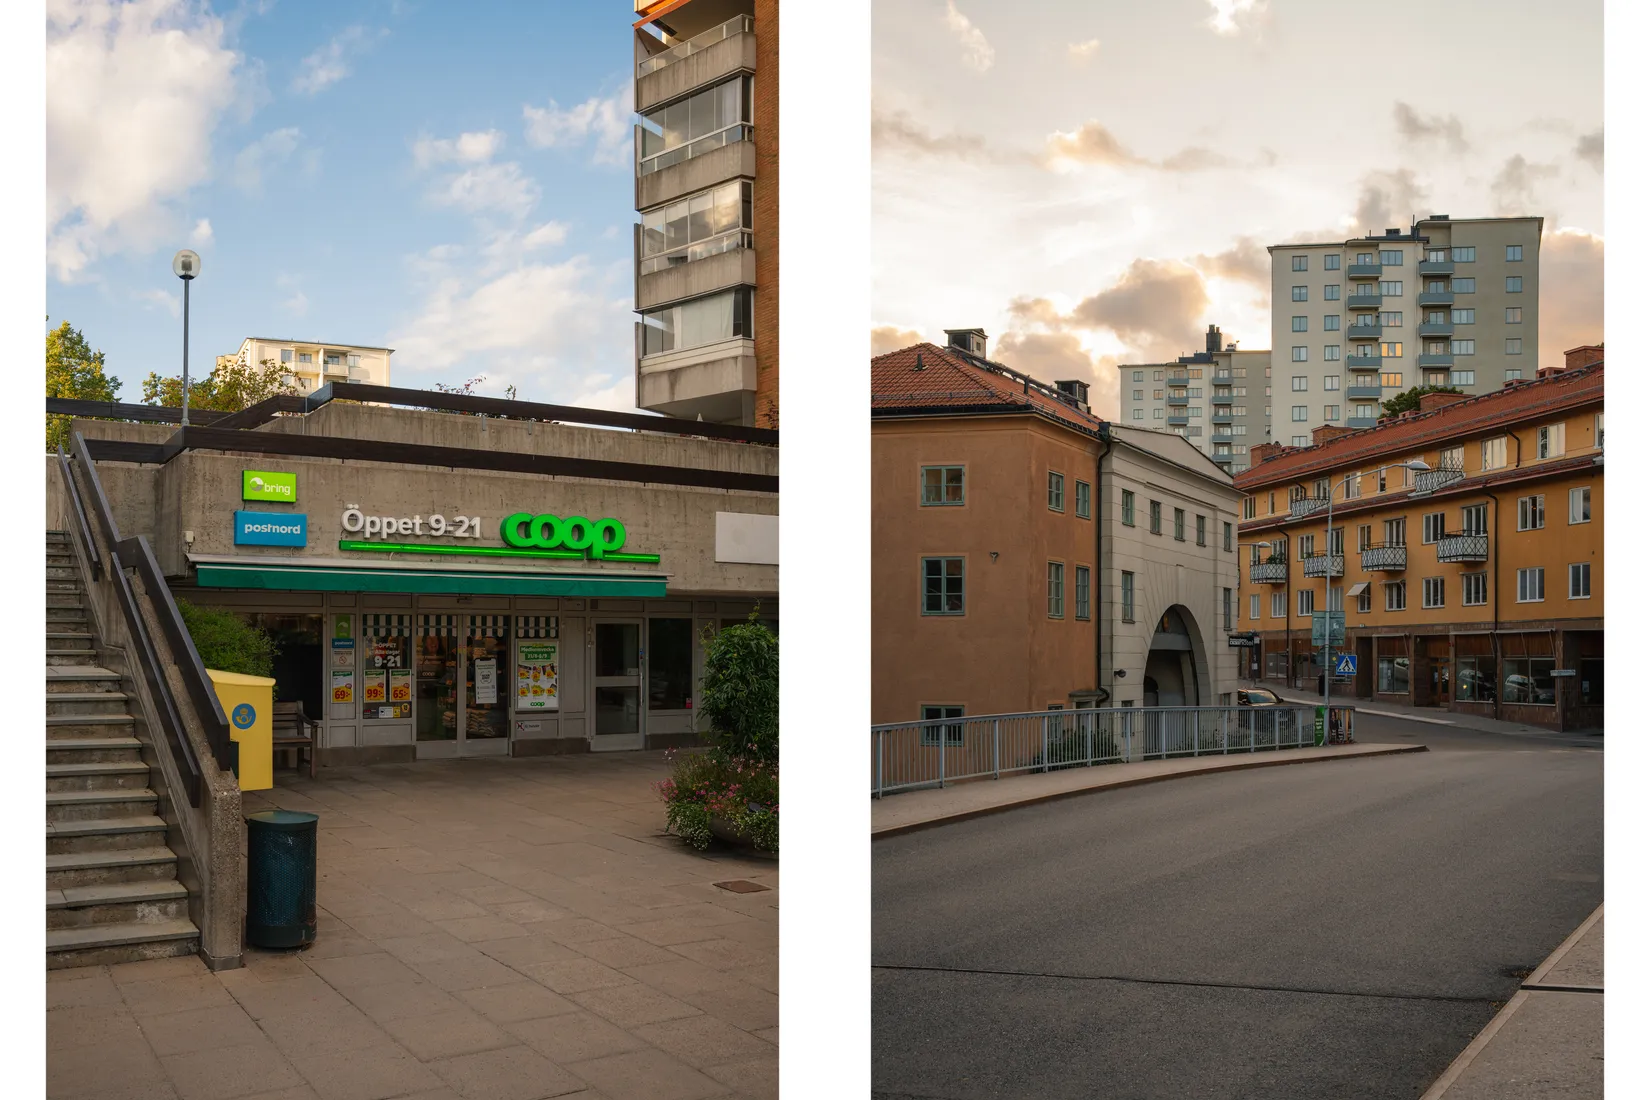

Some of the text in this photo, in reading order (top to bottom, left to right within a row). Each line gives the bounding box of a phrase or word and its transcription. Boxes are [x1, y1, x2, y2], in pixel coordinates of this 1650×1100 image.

[264, 483, 291, 496] bring
[340, 503, 481, 539] Öppet 9-21
[244, 524, 301, 534] postnord
[501, 512, 626, 559] coop
[374, 655, 401, 667] 9-21
